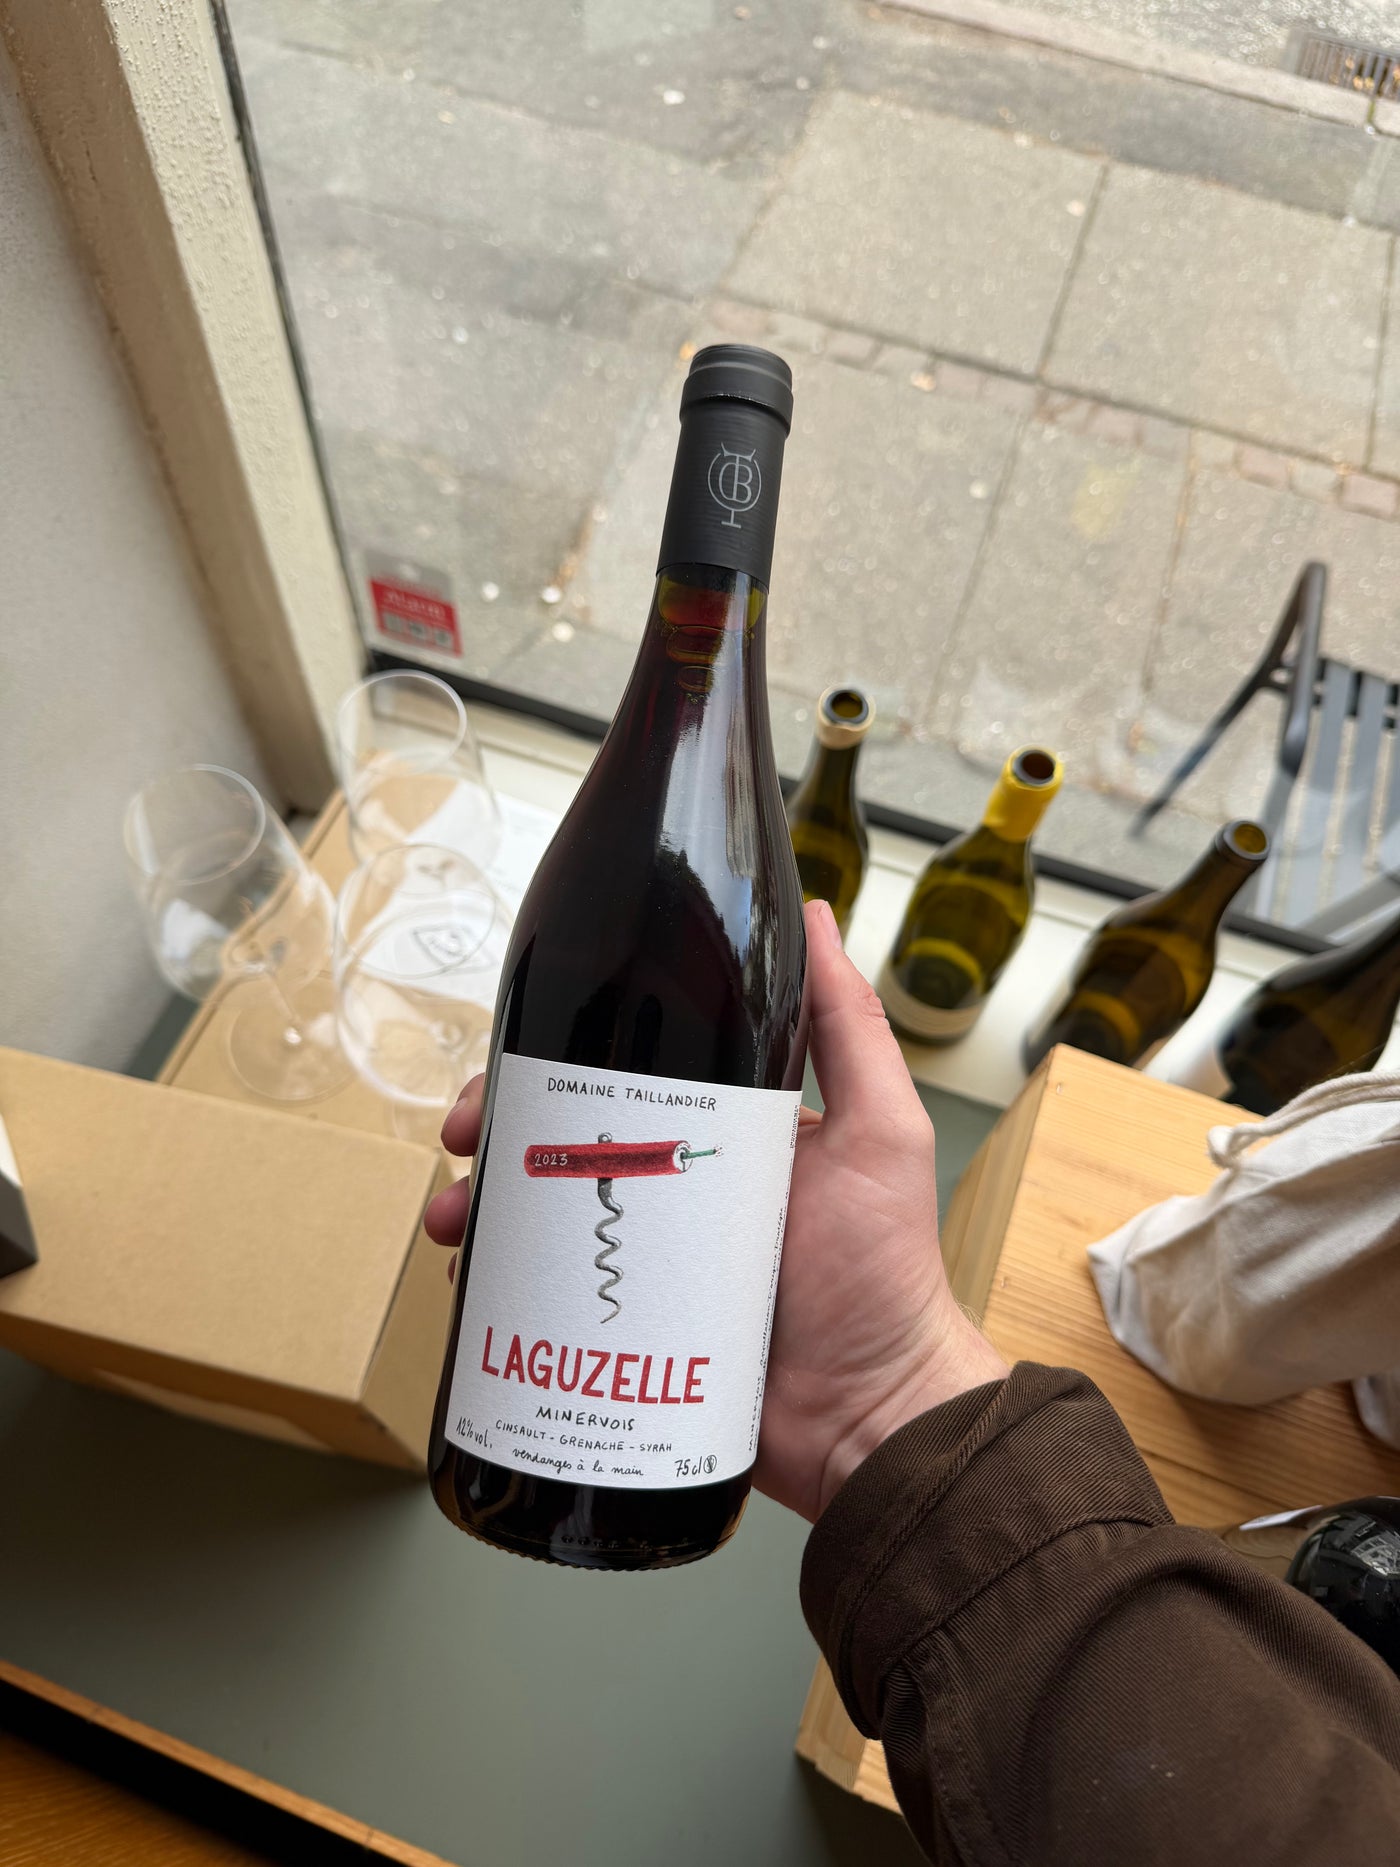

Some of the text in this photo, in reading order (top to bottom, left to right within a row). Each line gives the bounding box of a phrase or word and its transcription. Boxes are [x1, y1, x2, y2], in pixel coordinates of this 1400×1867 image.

[547, 1077, 717, 1112] DOMAINE TAILLANDIER
[534, 1152, 569, 1166] 2023
[481, 1325, 710, 1404] LAGUZELLE
[535, 1405, 635, 1431] MINERVOIS
[495, 1419, 546, 1440] CINSAULT
[559, 1434, 625, 1452] GRENACHE
[639, 1443, 672, 1453] SYRAH
[512, 1448, 644, 1476] vendanges à la main
